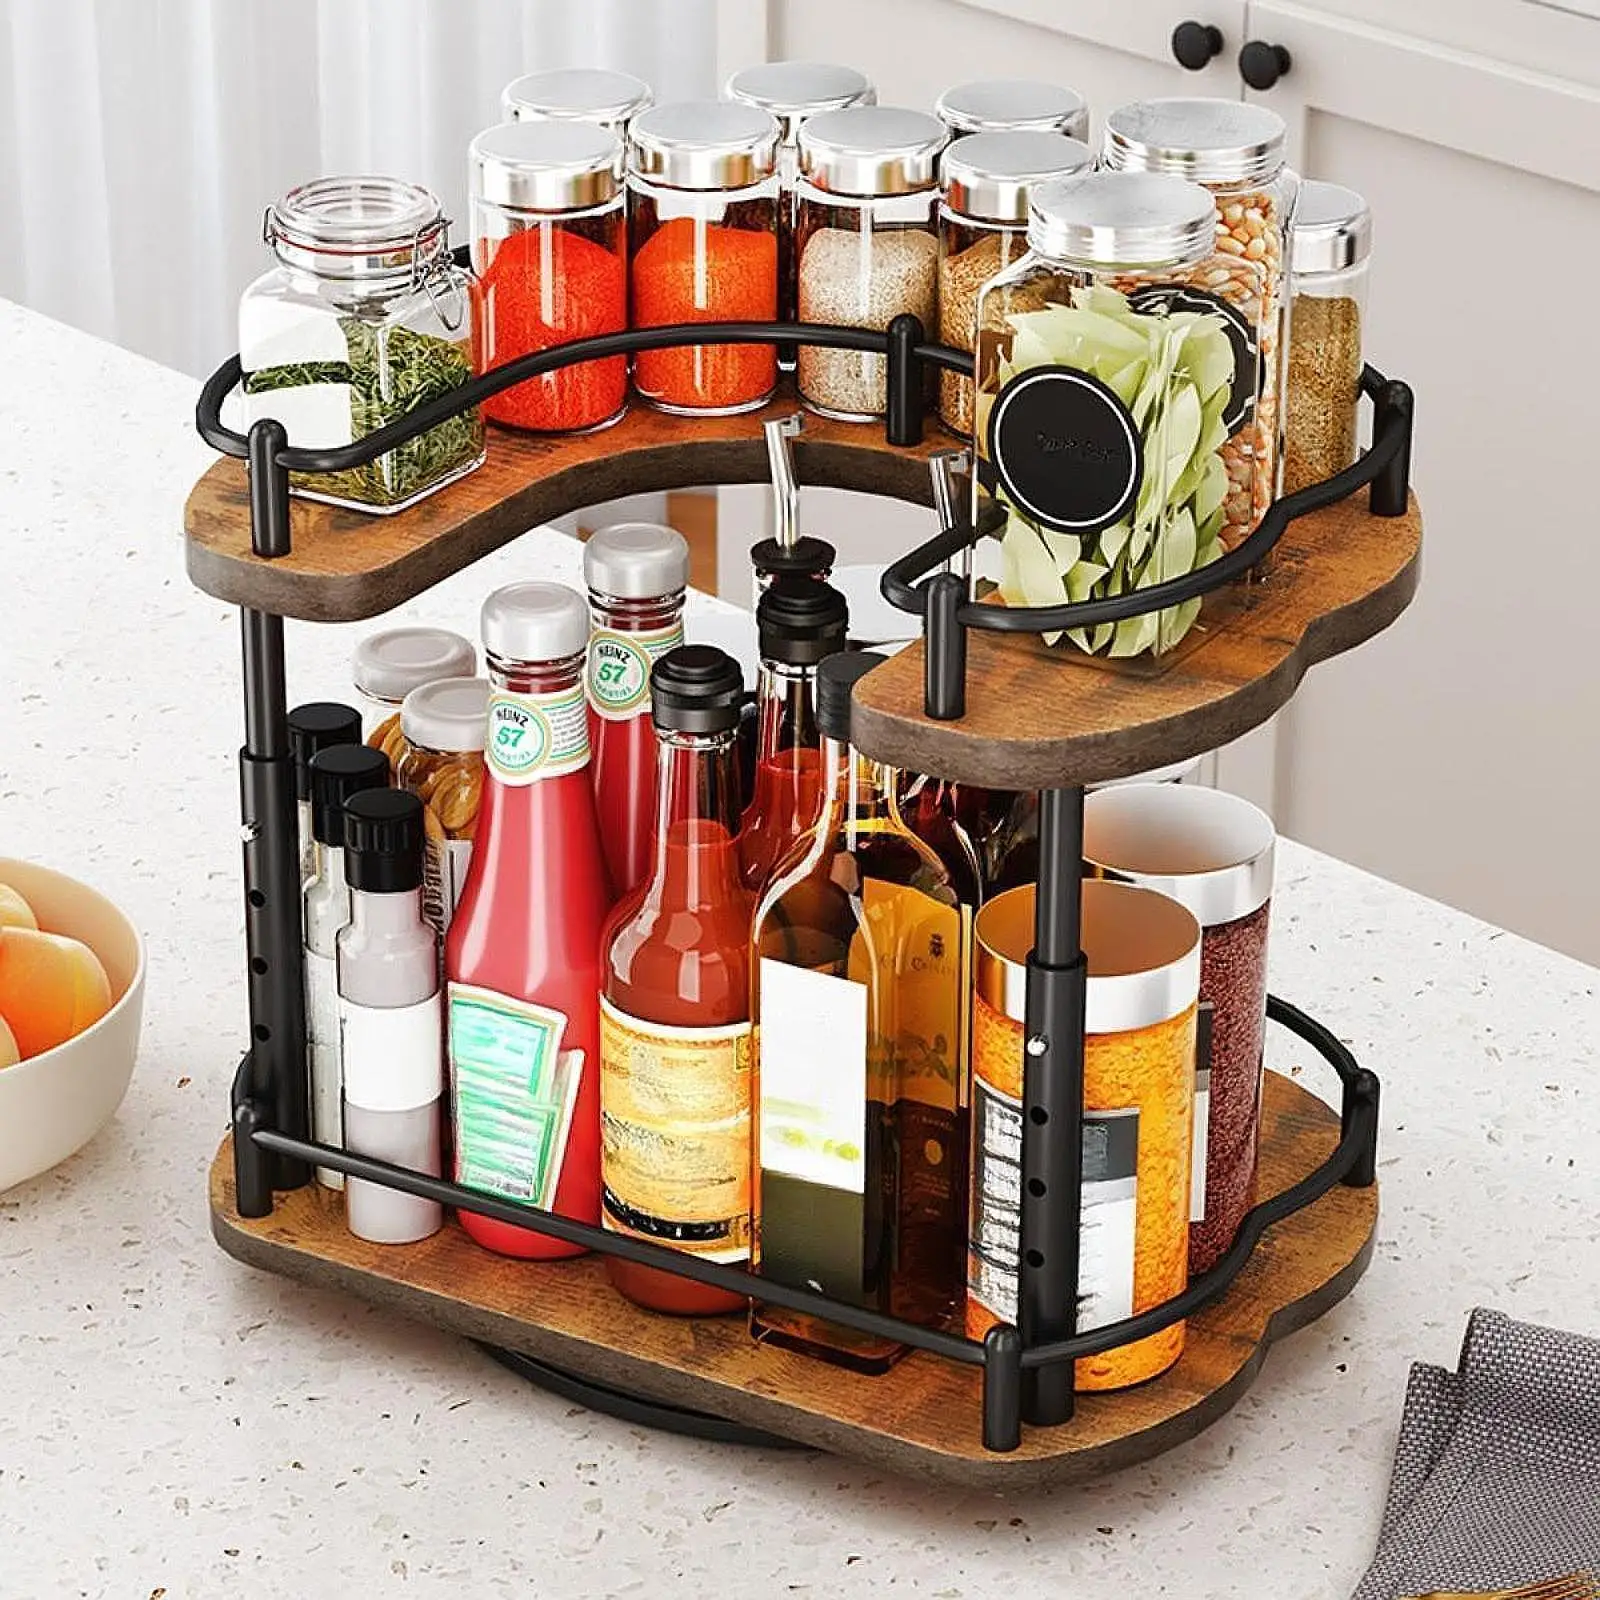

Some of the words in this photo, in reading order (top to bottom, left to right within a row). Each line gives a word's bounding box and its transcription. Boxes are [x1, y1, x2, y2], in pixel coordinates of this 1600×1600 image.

[597, 645, 630, 664] HEINZ
[598, 662, 627, 682] 57
[496, 707, 529, 727] HEINZ
[496, 726, 525, 748] 57
